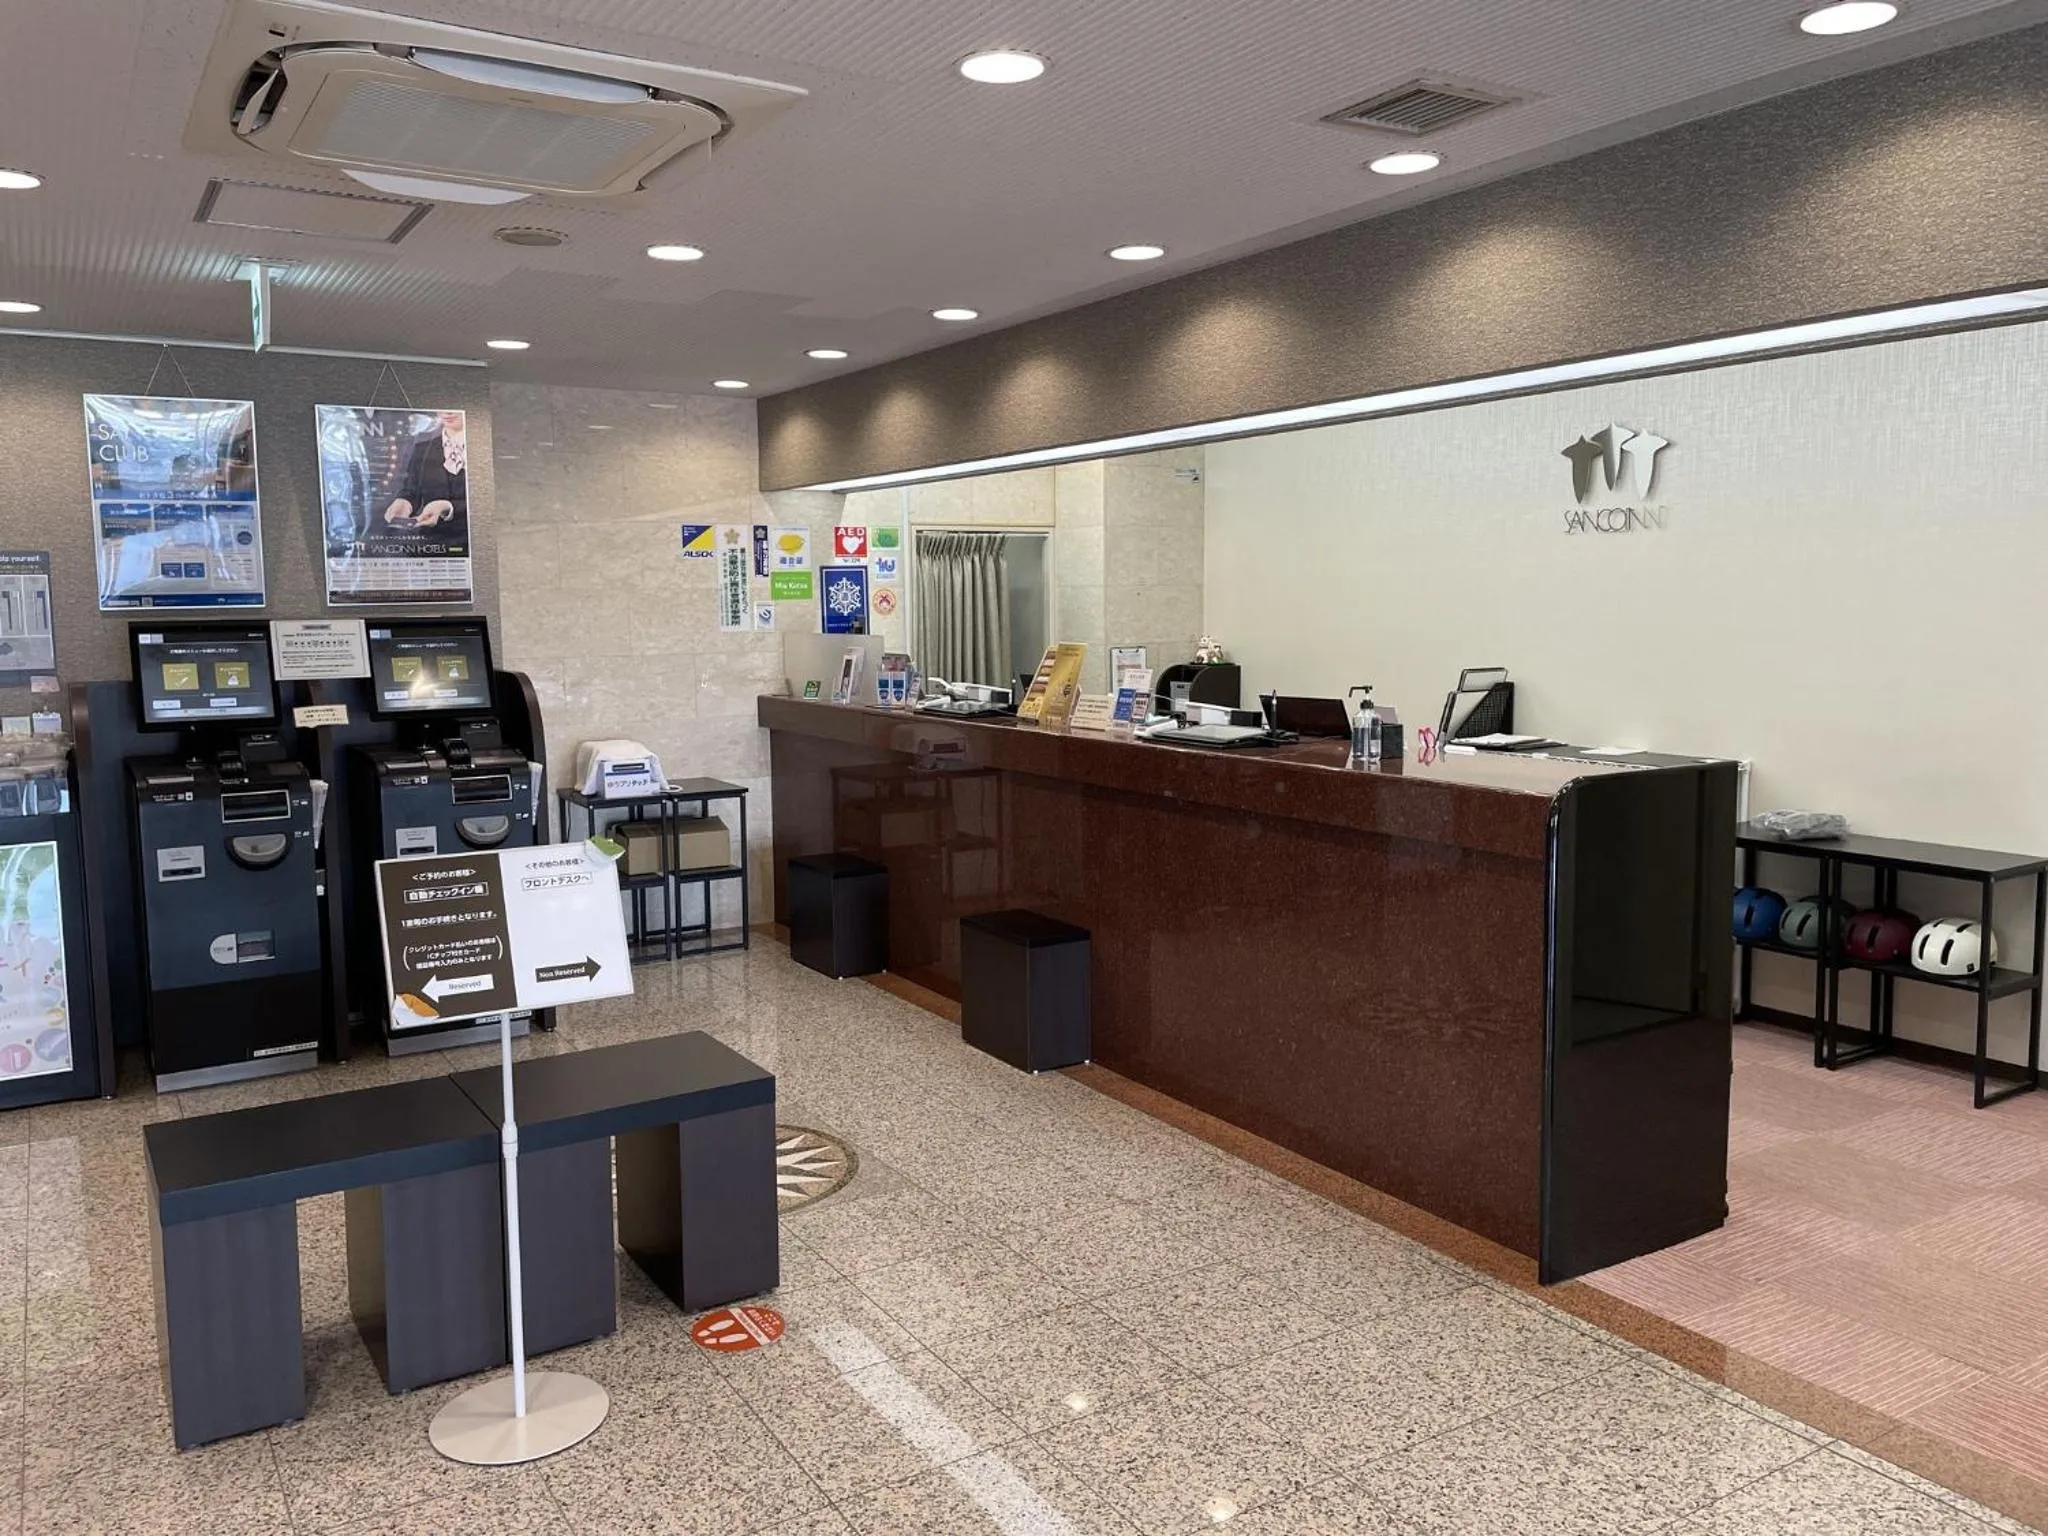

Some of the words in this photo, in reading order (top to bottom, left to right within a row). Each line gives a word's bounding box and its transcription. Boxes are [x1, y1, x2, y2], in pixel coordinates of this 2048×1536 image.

[837, 527, 865, 536] AED
[683, 550, 714, 558] ALSOK
[524, 874, 590, 888] フロントデスクへ
[408, 884, 485, 900] 自動チェックイン機
[554, 966, 586, 977] Reserved
[448, 980, 482, 990] Reserved
